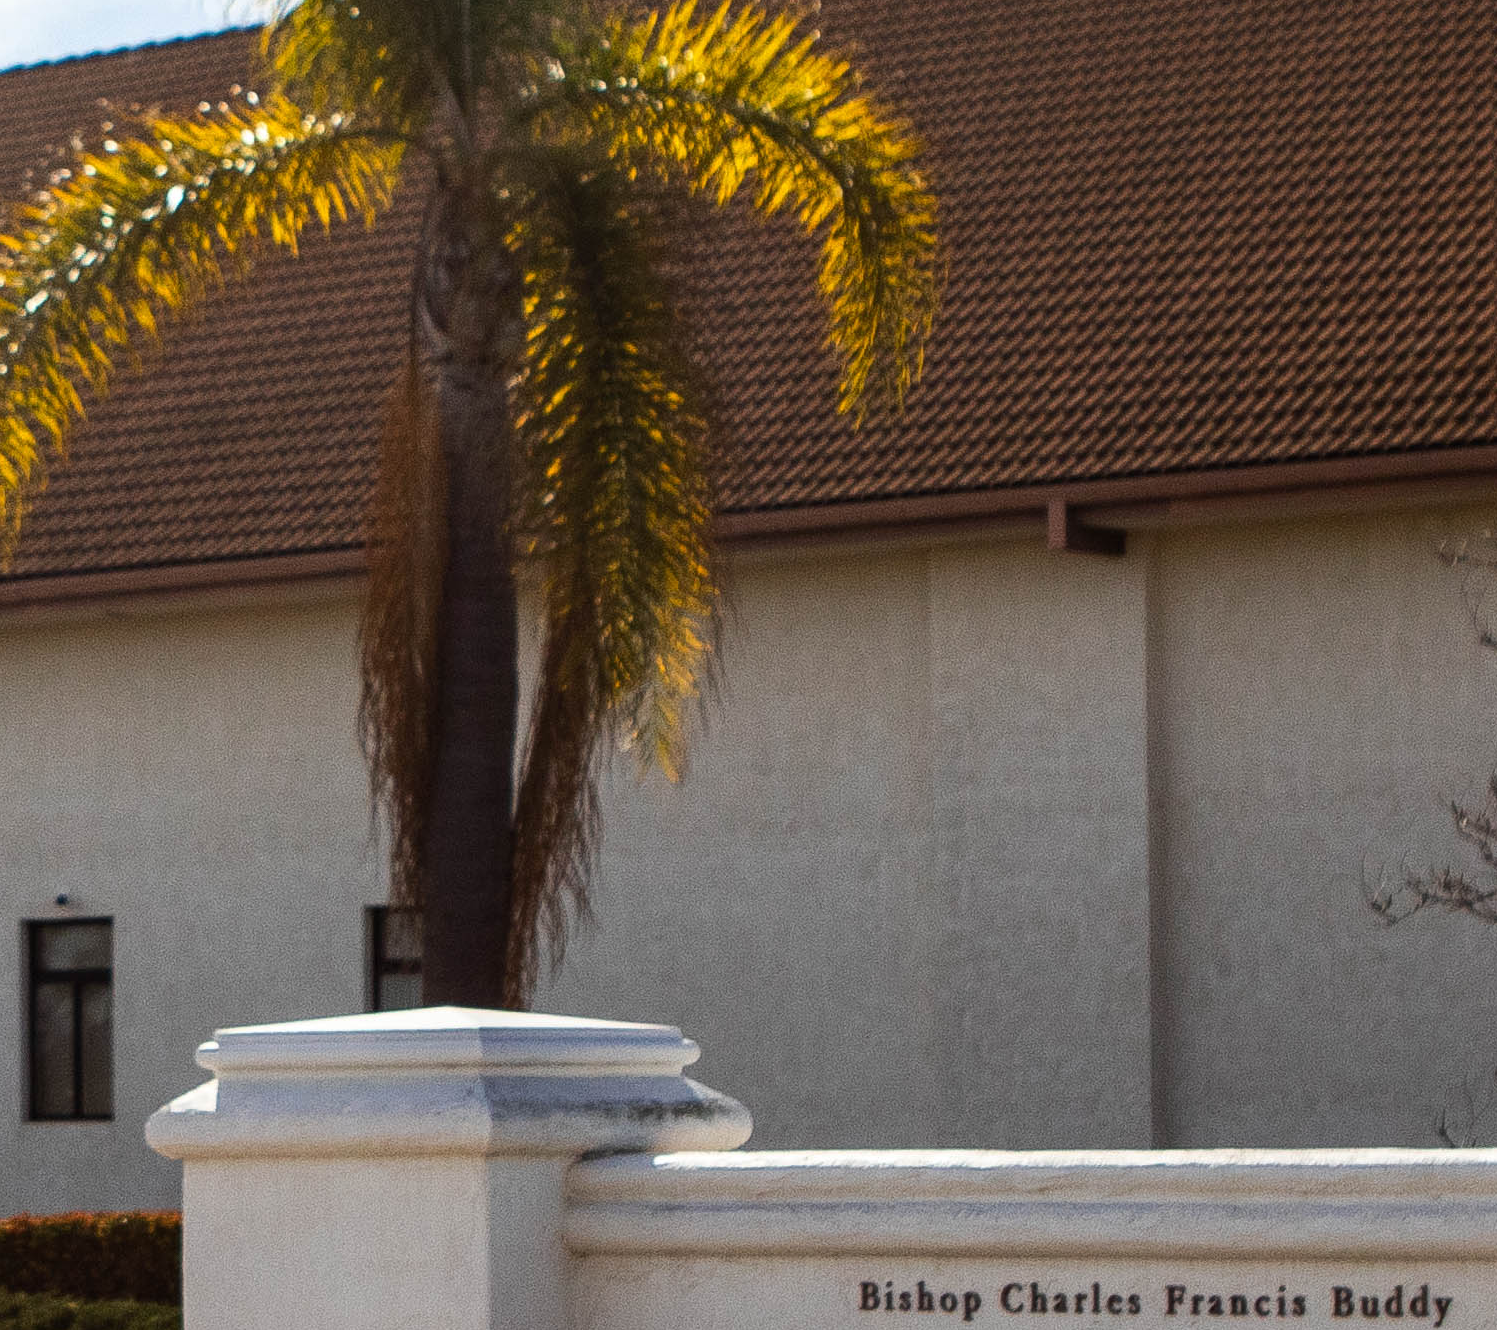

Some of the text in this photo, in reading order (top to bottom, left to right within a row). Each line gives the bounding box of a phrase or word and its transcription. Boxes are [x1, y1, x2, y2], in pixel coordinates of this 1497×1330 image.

[859, 1280, 1453, 1328] Bishop Charles Francis Buddy
